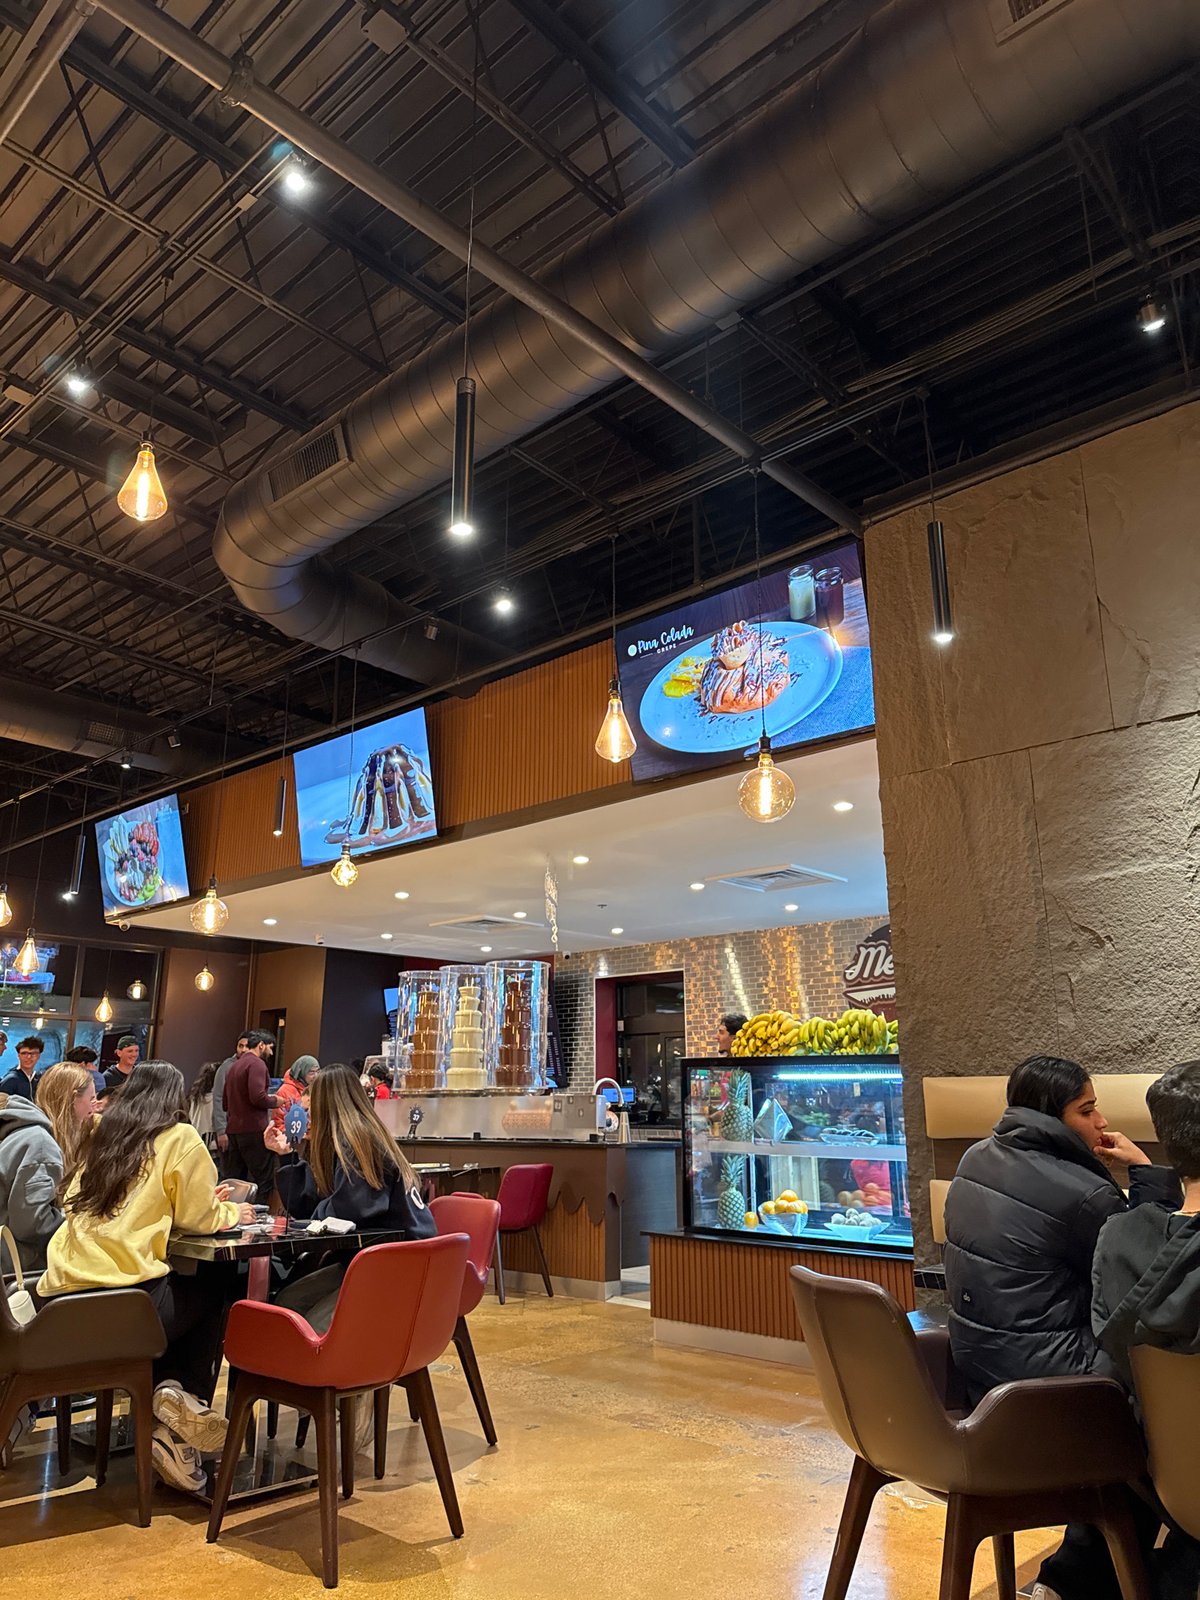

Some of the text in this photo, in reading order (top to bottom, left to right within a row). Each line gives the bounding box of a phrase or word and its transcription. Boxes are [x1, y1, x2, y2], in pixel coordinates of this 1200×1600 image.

[638, 625, 694, 654] Pina Colada
[657, 644, 677, 654] CREPE
[290, 1120, 302, 1134] 39
